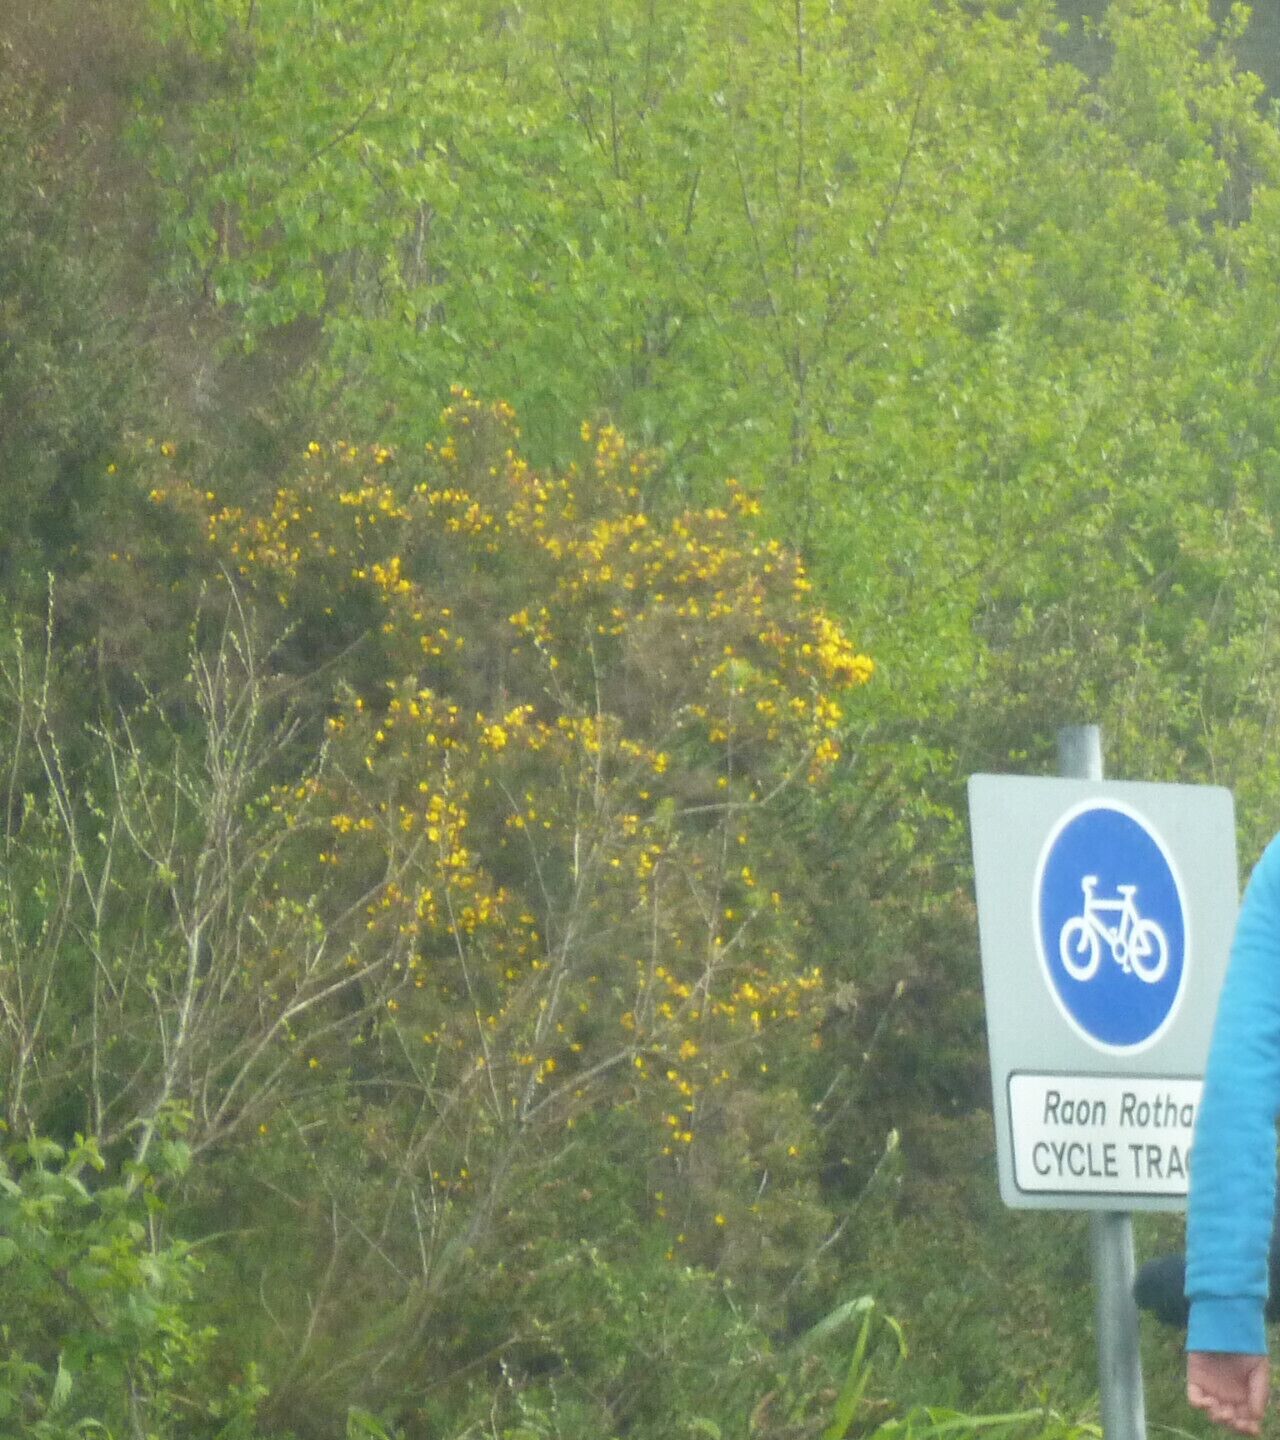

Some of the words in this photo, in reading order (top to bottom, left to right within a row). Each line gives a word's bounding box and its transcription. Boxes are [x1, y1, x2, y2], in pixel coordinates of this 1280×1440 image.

[1043, 1089, 1106, 1126] Raon
[1119, 1092, 1194, 1128] Rotha
[1032, 1141, 1119, 1177] CYCLE
[1128, 1143, 1191, 1179] TRA
